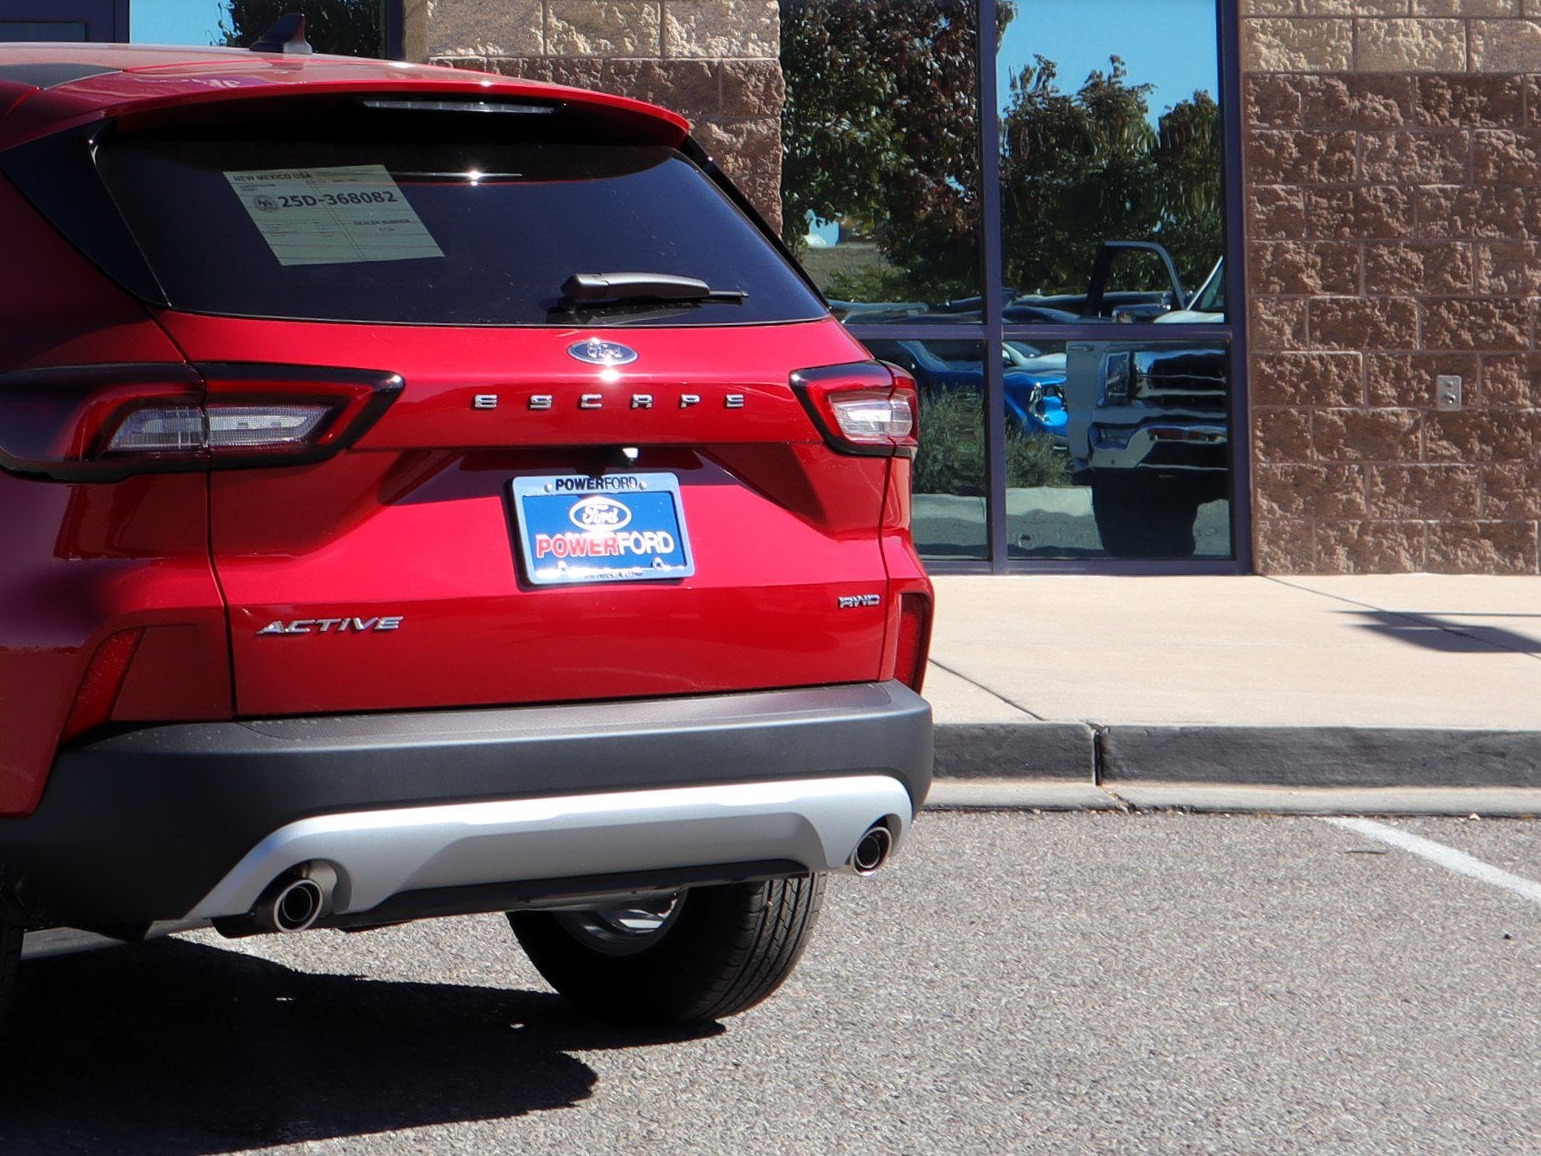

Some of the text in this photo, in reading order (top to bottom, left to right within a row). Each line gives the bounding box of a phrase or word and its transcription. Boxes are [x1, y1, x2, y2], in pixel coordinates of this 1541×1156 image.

[233, 174, 255, 182] NEW
[257, 172, 292, 181] MEXICO
[293, 171, 313, 179] USA
[278, 191, 398, 208] 25D-368082
[474, 393, 745, 410] ESCAPE
[582, 504, 620, 525] Ford
[256, 616, 404, 634] ACTIVE
